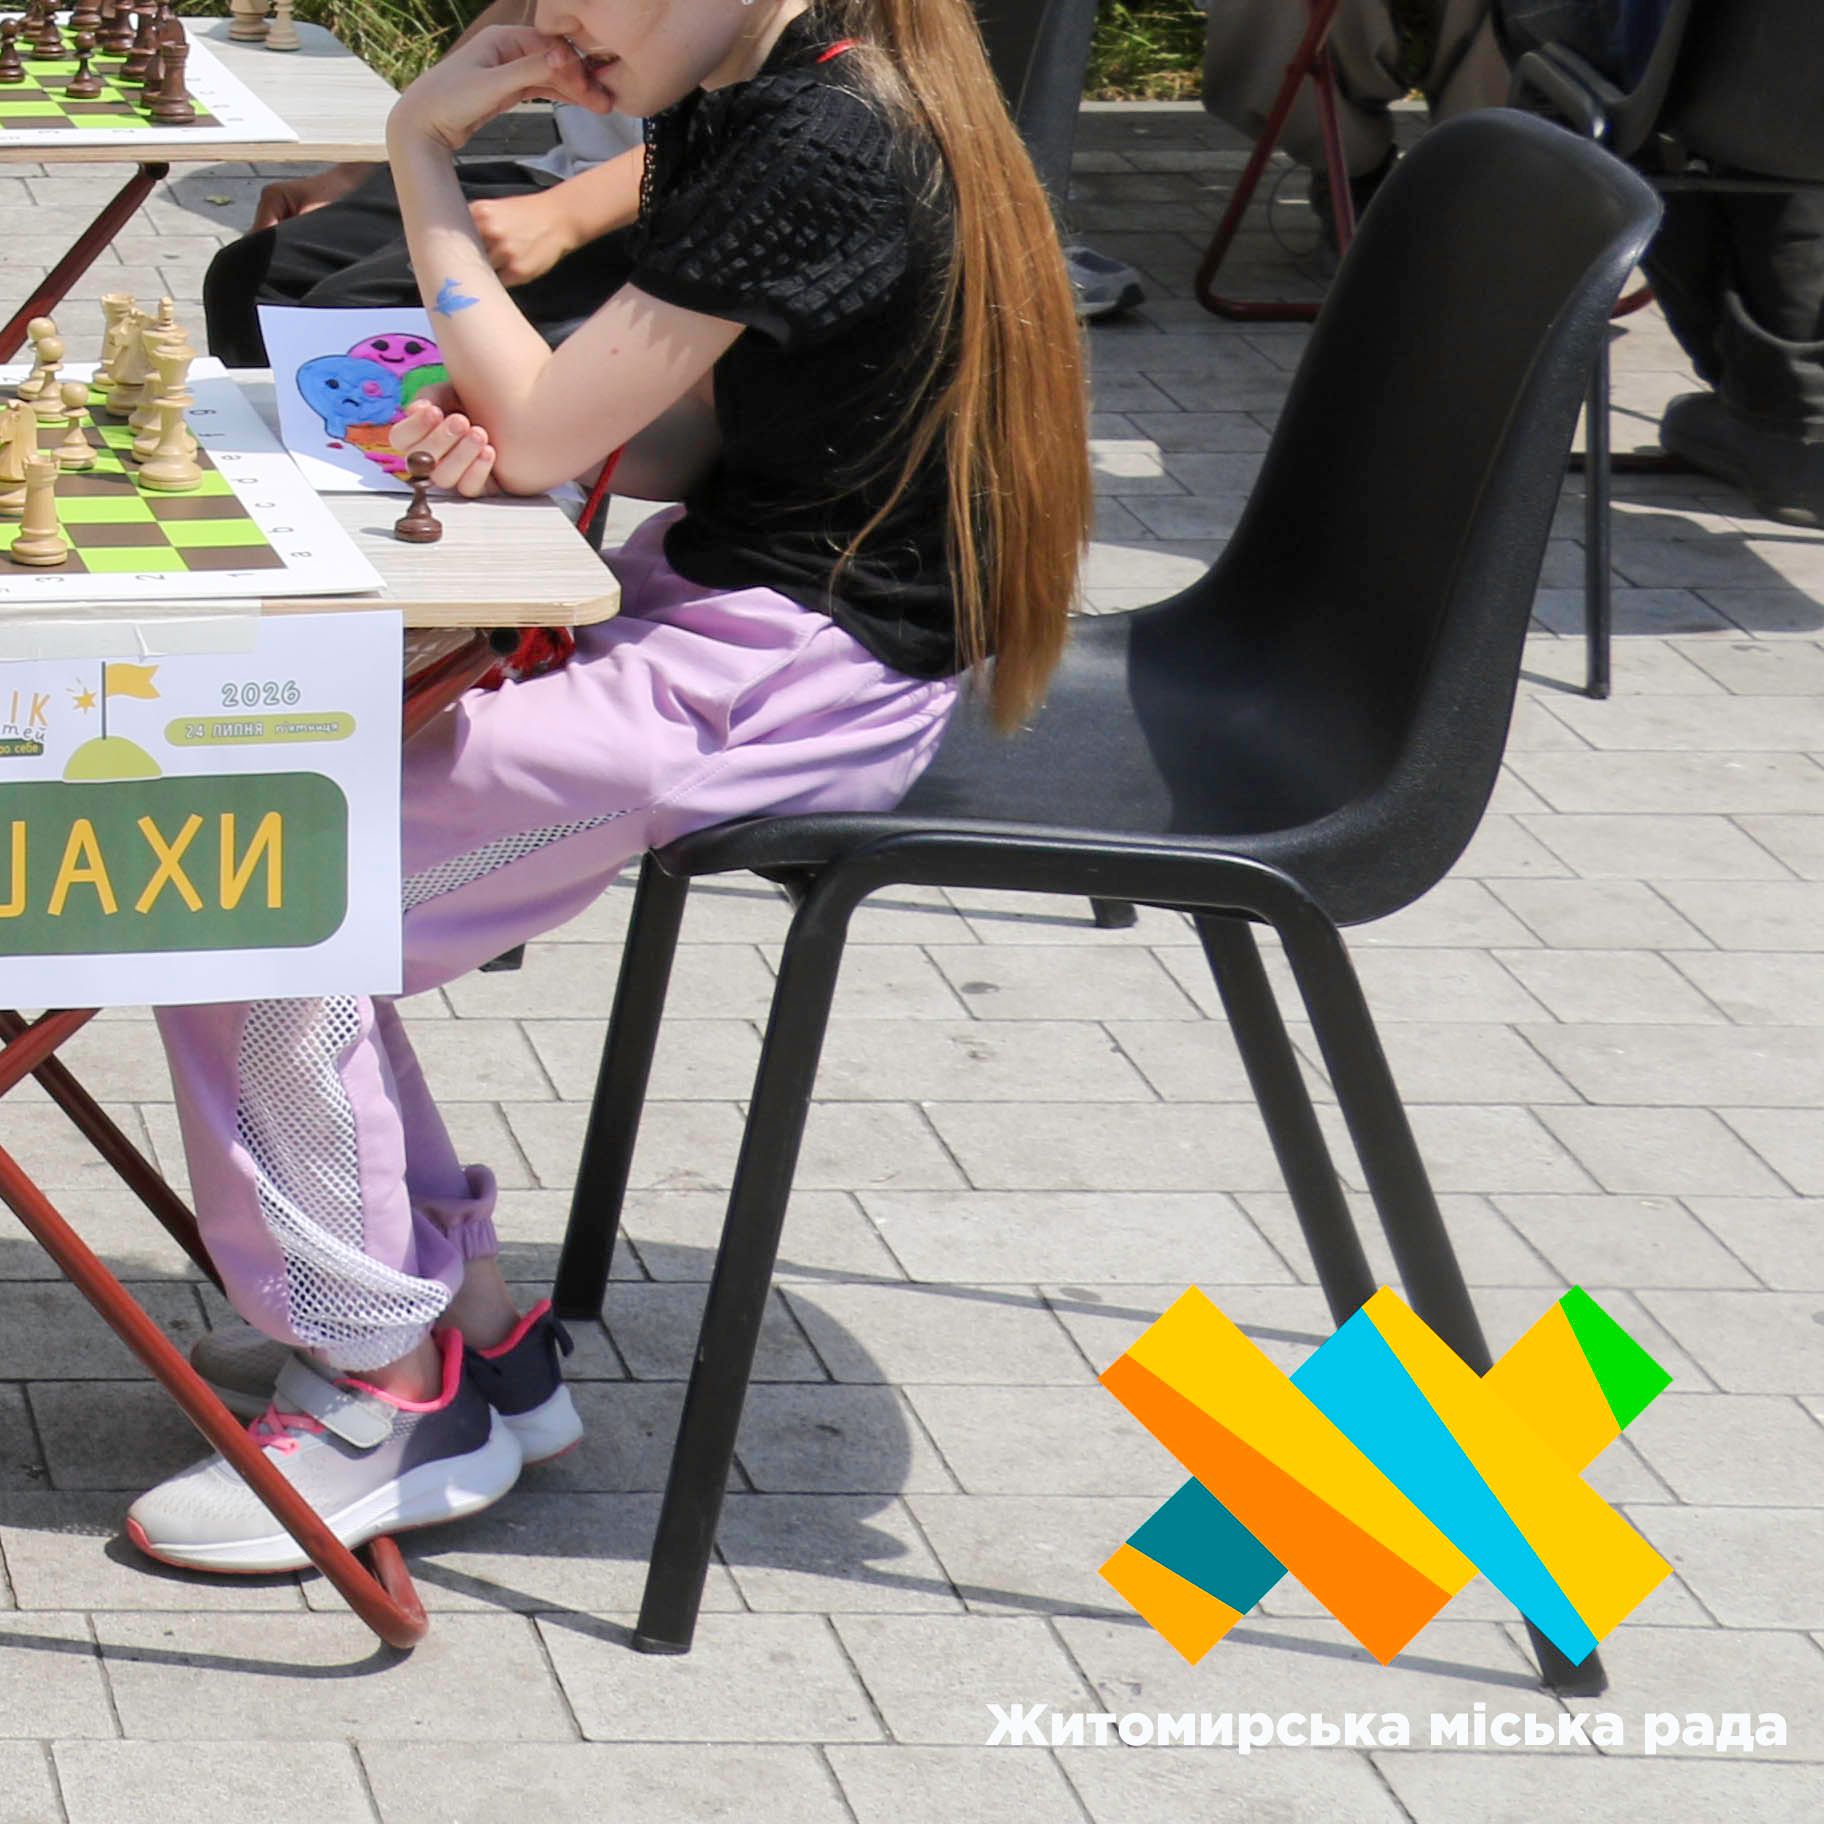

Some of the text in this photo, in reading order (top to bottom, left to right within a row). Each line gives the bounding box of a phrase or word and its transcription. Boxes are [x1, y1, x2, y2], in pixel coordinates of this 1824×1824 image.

[221, 680, 301, 708] 2026
[185, 724, 205, 739] 24
[211, 722, 265, 738] ЛИПНЯ
[14, 741, 39, 754] себе
